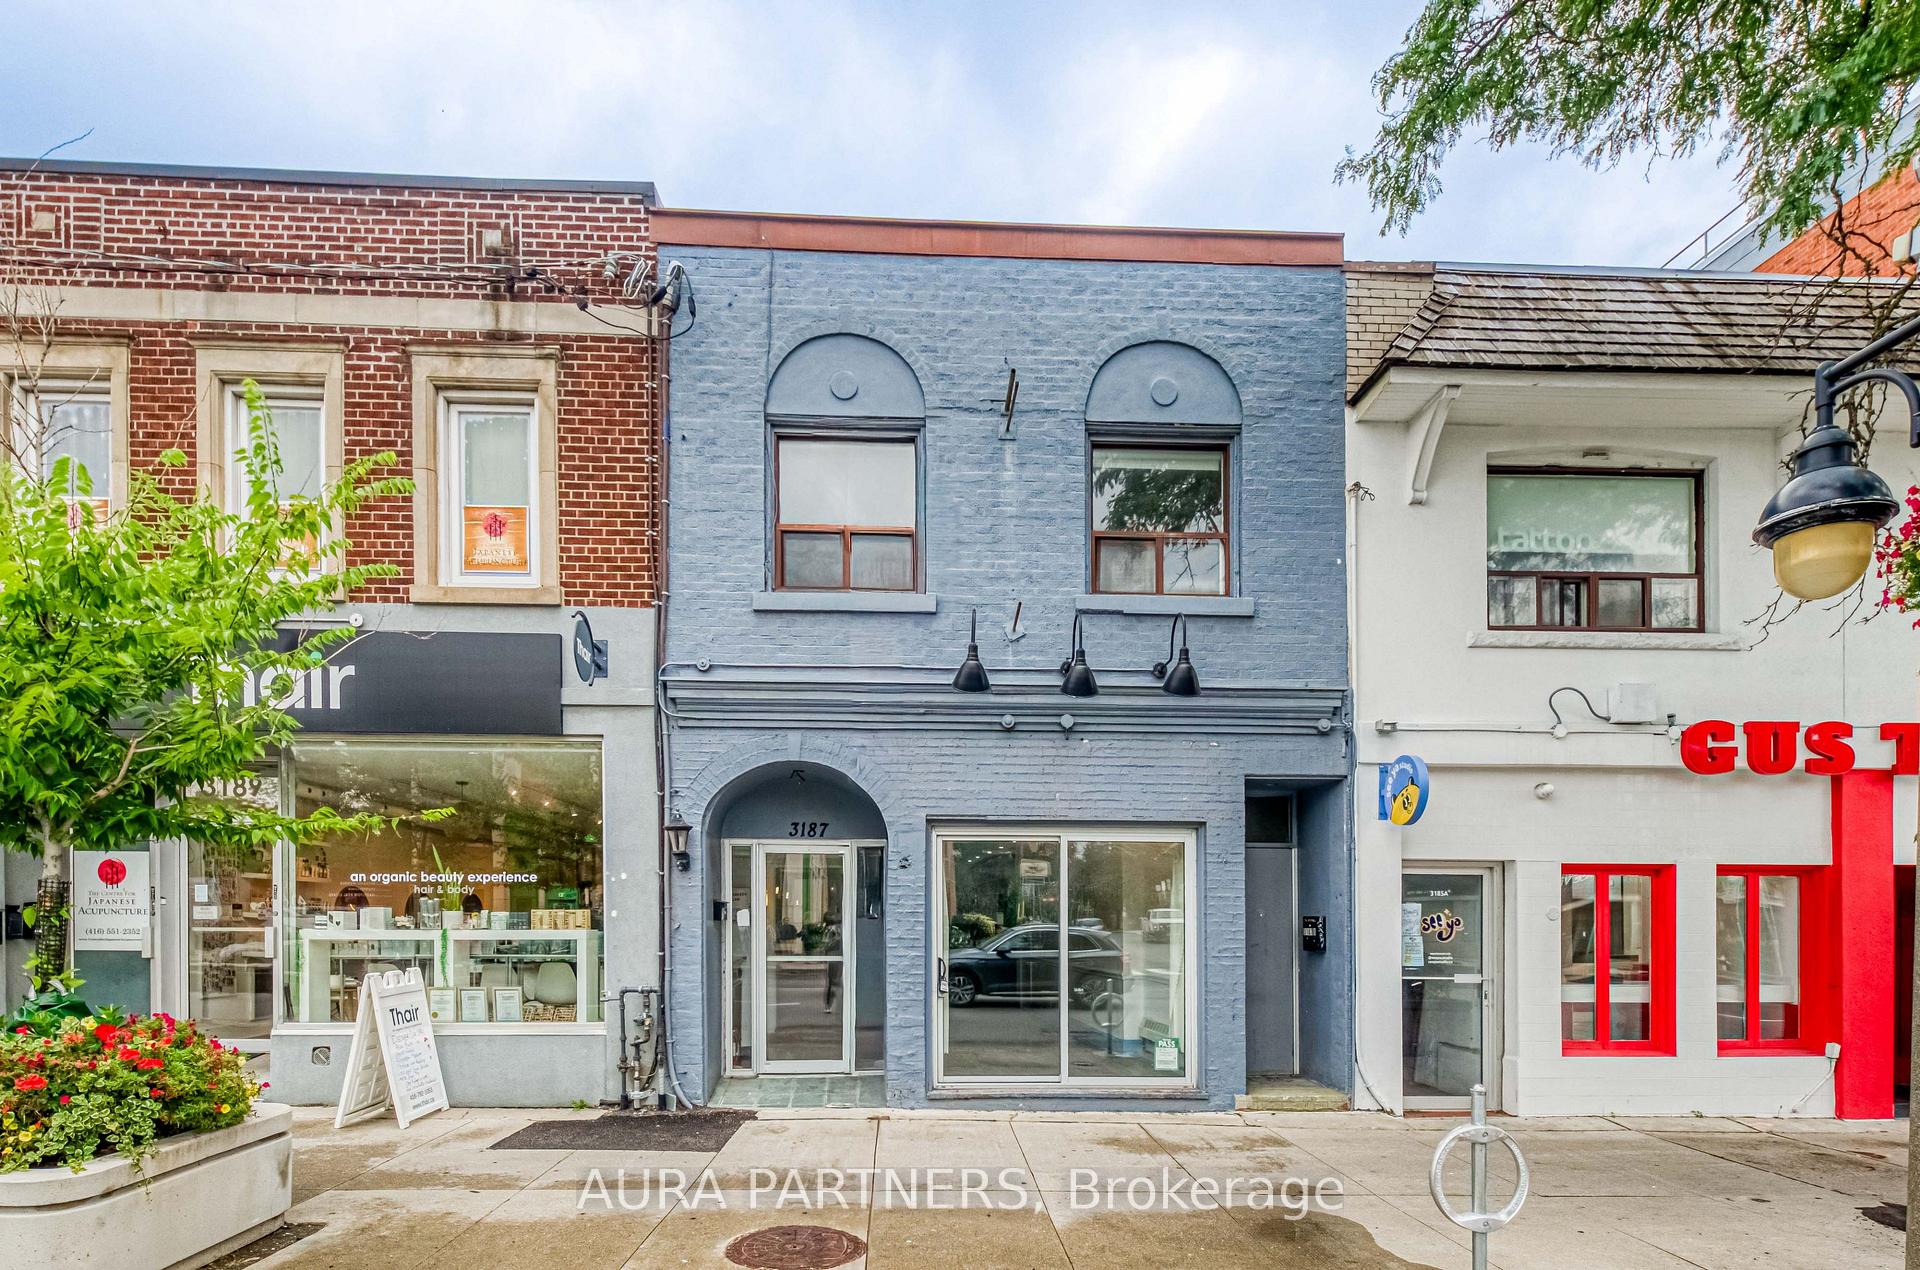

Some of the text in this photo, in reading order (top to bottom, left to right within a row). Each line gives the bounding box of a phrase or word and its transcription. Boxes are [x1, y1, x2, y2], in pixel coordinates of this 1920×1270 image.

[1497, 526, 1592, 552] tattoo
[1681, 719, 1855, 776] GUS
[789, 821, 830, 838] 3187
[350, 871, 538, 884] an organic beauty experience
[413, 884, 475, 896] hair & body
[88, 897, 136, 906] JAPANESE
[78, 907, 148, 916] ACUPUNCTURE
[85, 928, 105, 936] (416)
[389, 1004, 419, 1027] Thair
[1158, 1040, 1176, 1048] PASS
